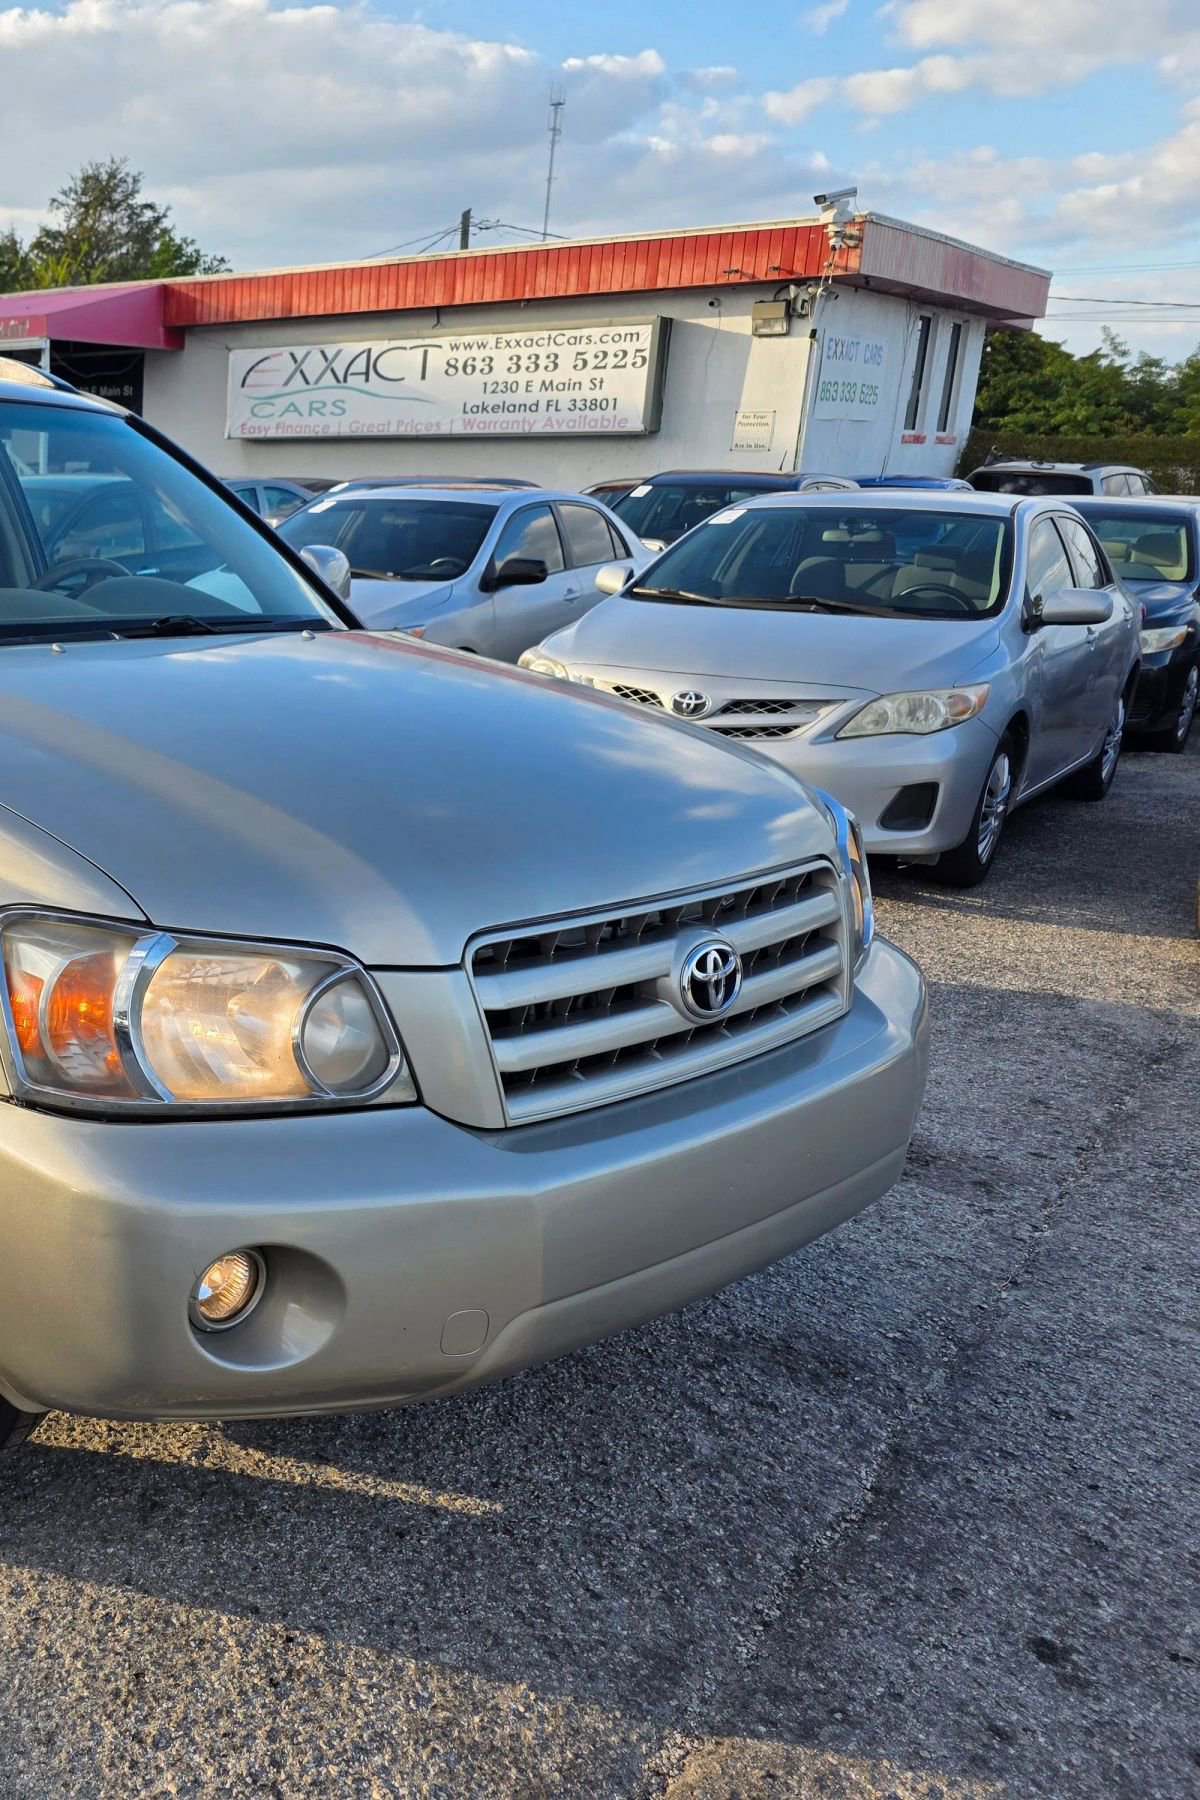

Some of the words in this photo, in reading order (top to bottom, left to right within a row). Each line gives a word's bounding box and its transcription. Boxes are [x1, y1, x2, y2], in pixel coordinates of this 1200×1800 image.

[449, 331, 640, 352] www.ExxactCars.com
[827, 337, 860, 362] EXXACT
[864, 343, 883, 366] CARS
[241, 344, 442, 388] EXXACT
[444, 356, 494, 377] 863
[507, 352, 559, 374] 333
[573, 348, 648, 372] 5225
[100, 385, 121, 396] Main
[482, 380, 519, 395] 1230
[525, 380, 534, 393] E
[539, 379, 582, 393] Main
[589, 377, 604, 391] St
[820, 380, 839, 402] 863
[250, 400, 346, 418] CARS
[463, 400, 539, 415] Lakeland
[546, 400, 561, 413] FL
[568, 398, 618, 412] 33801
[240, 422, 271, 437] Easy
[275, 421, 330, 437] Finance
[349, 419, 390, 434] Great
[396, 419, 441, 432] Prices
[462, 417, 535, 433] Warranty
[542, 414, 629, 430] Available
